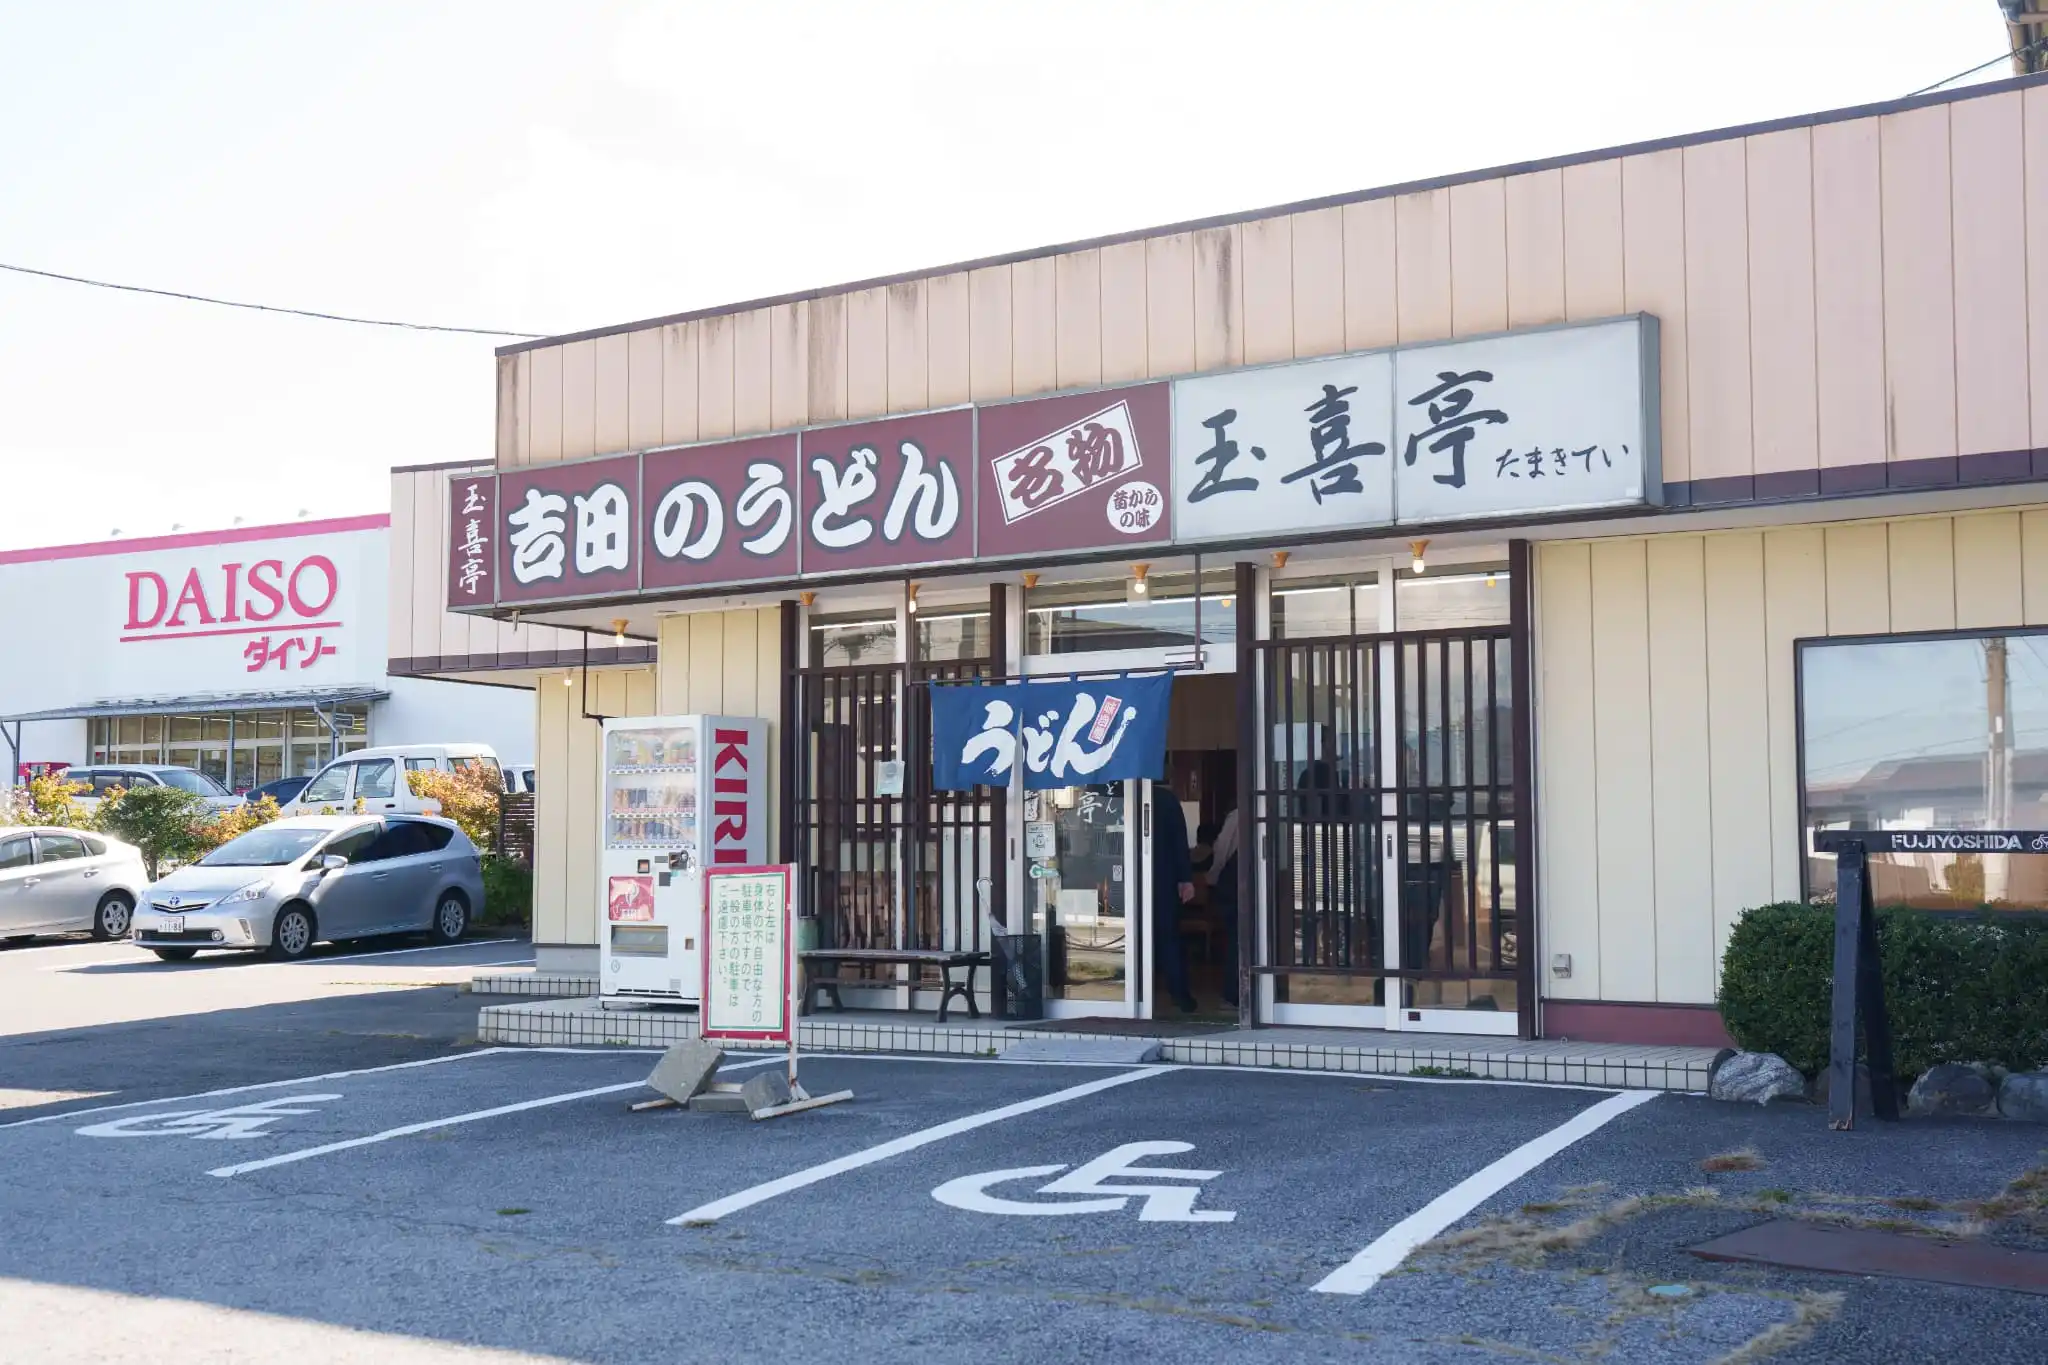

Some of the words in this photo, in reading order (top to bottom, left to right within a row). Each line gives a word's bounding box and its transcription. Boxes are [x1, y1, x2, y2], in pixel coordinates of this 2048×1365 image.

[1008, 422, 1124, 509] 名物
[1186, 370, 1509, 505] 玉喜亭
[1496, 444, 1630, 478] たまきてい
[458, 483, 488, 595] 玉喜亭
[509, 442, 959, 584] 吉田のうどん
[1113, 488, 1158, 510] 昔から
[1119, 508, 1151, 528] の味
[124, 555, 338, 629] DAISO
[244, 636, 336, 672] ダイソー
[961, 692, 1137, 778] うどん
[715, 729, 748, 864] KIRI
[1891, 834, 2023, 849] FUJIYOSHIDA
[741, 883, 752, 992] 駐車場ですので
[752, 882, 764, 1023] 身体の不自由な方の
[765, 883, 776, 944] 右と左は
